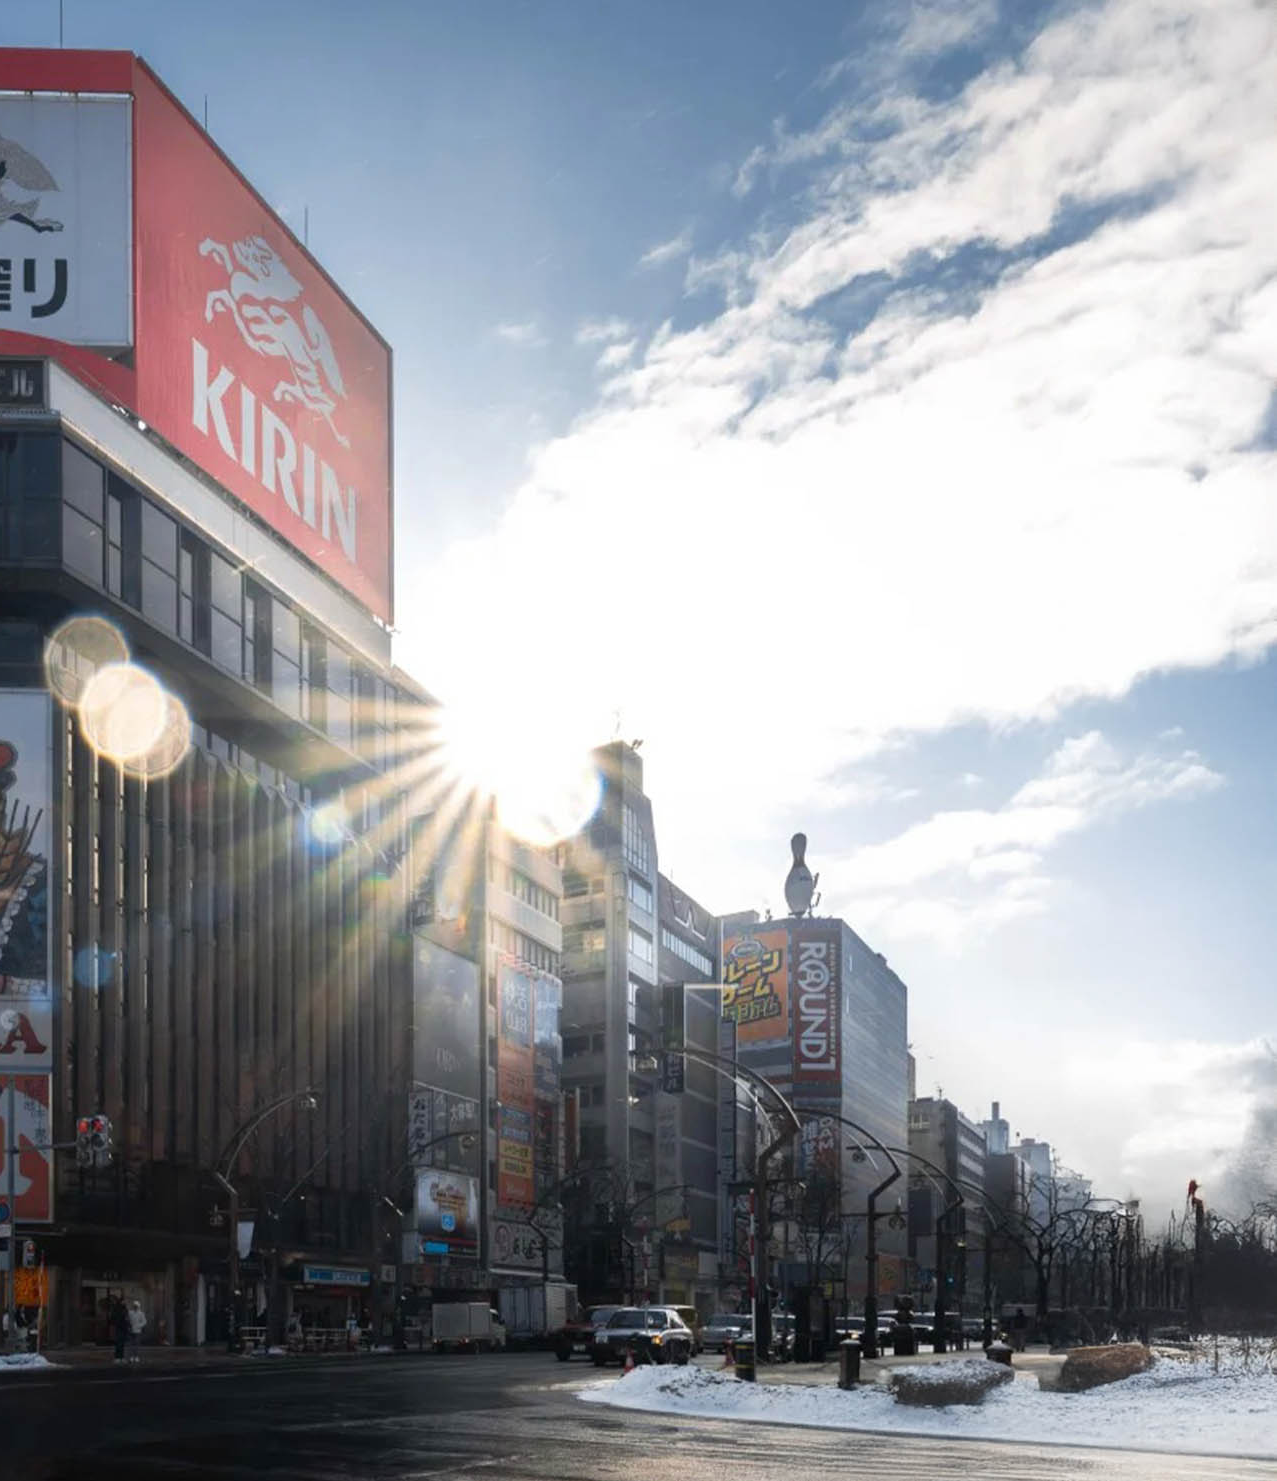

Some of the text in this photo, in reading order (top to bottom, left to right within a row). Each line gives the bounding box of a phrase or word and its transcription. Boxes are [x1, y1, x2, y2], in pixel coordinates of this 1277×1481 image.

[192, 337, 357, 563] KIRIN
[723, 949, 780, 984] レーン
[799, 942, 836, 1071] ROUND1
